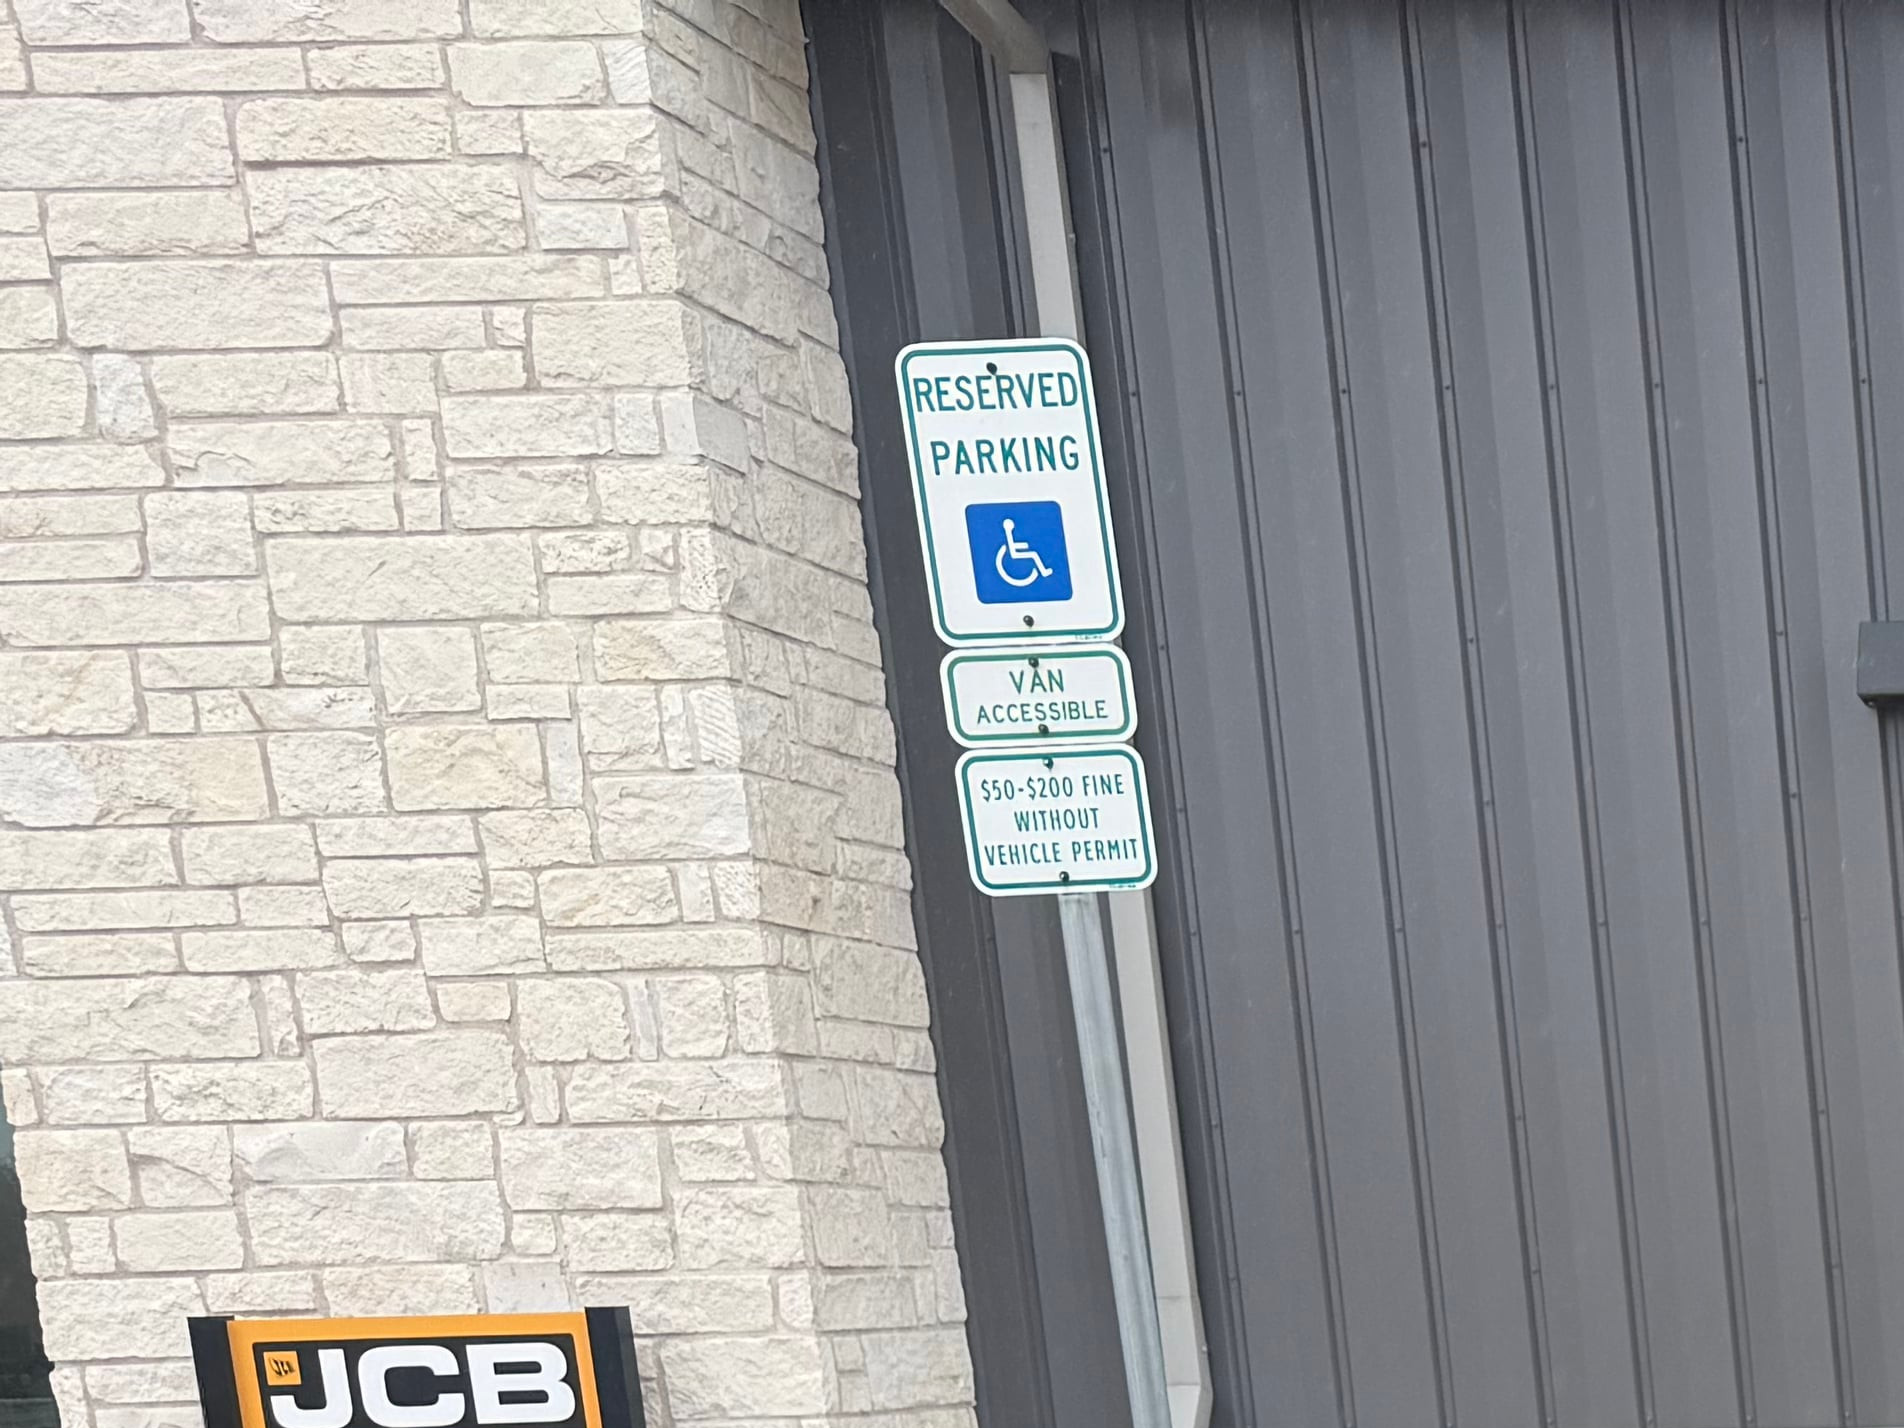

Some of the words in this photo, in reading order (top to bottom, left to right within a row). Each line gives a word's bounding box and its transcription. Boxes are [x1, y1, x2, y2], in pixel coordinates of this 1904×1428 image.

[913, 371, 1079, 413] RESERVED
[930, 435, 1080, 476] PARKING
[1009, 669, 1065, 695] VAN
[977, 700, 1109, 724] ACCESSIBLE
[980, 776, 1074, 802] $50-$200
[1082, 774, 1125, 797] FINE
[1014, 807, 1100, 832] WITHOUT
[985, 841, 1062, 867] VEHICLE
[1071, 838, 1138, 863] PERMIT
